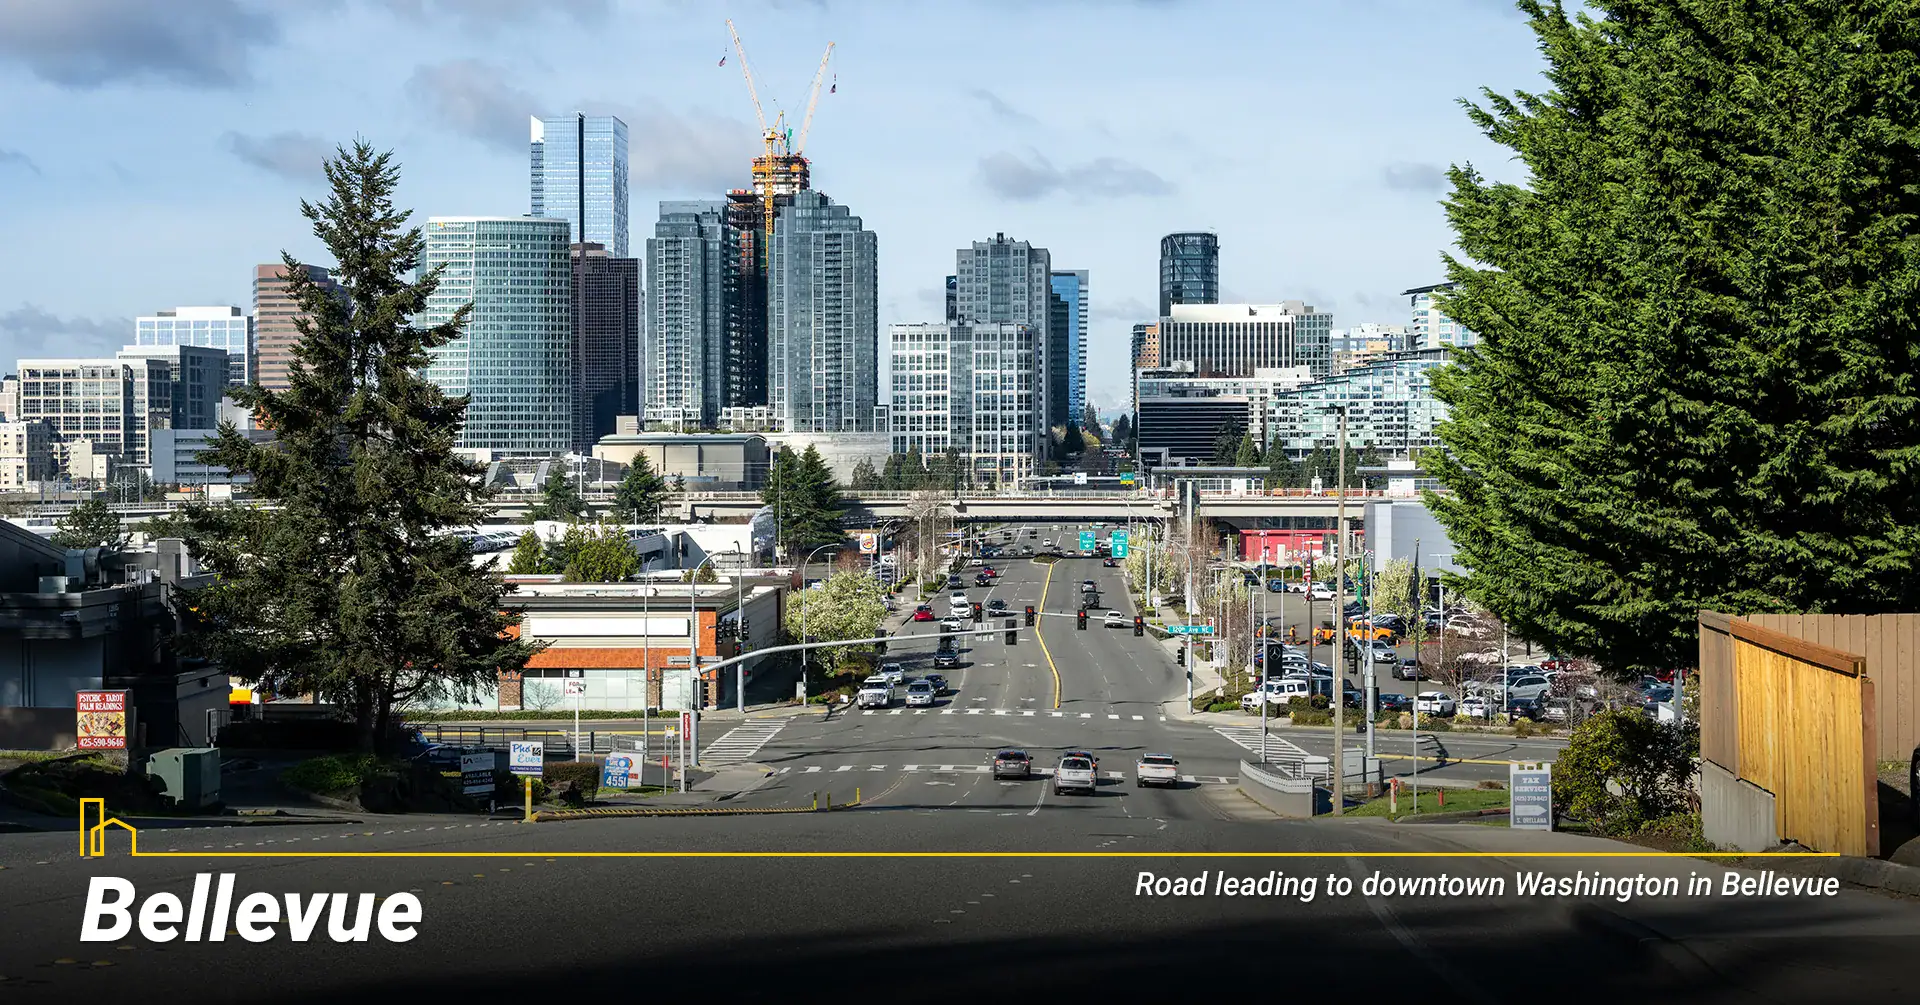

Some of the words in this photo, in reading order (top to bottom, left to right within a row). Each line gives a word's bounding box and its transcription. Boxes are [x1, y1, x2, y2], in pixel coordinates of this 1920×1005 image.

[105, 694, 124, 702] TAROT
[79, 702, 95, 710] PALM
[96, 702, 122, 710] READINGS
[606, 776, 627, 787] 4551
